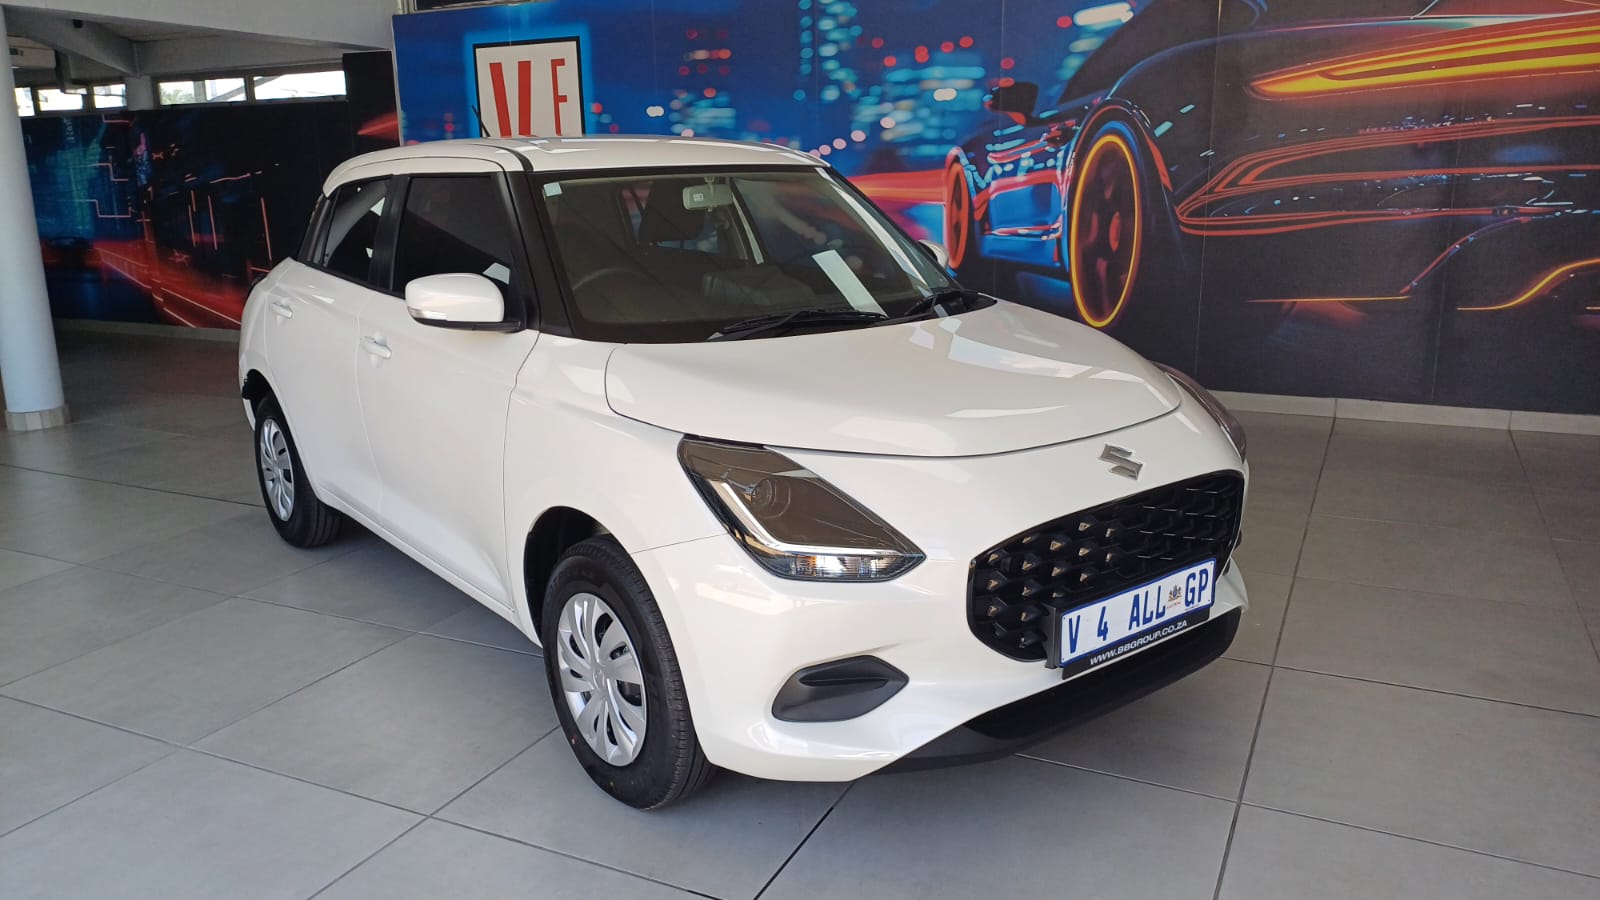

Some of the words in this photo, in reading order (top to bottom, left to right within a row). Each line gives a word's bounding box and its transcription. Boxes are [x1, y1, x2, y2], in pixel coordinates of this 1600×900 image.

[1068, 614, 1081, 654] V
[1097, 605, 1109, 642] 4
[1128, 585, 1166, 631] ALL
[1184, 568, 1209, 608] GP
[1089, 619, 1188, 666] WWW.BBGROUP.CO.ZA
